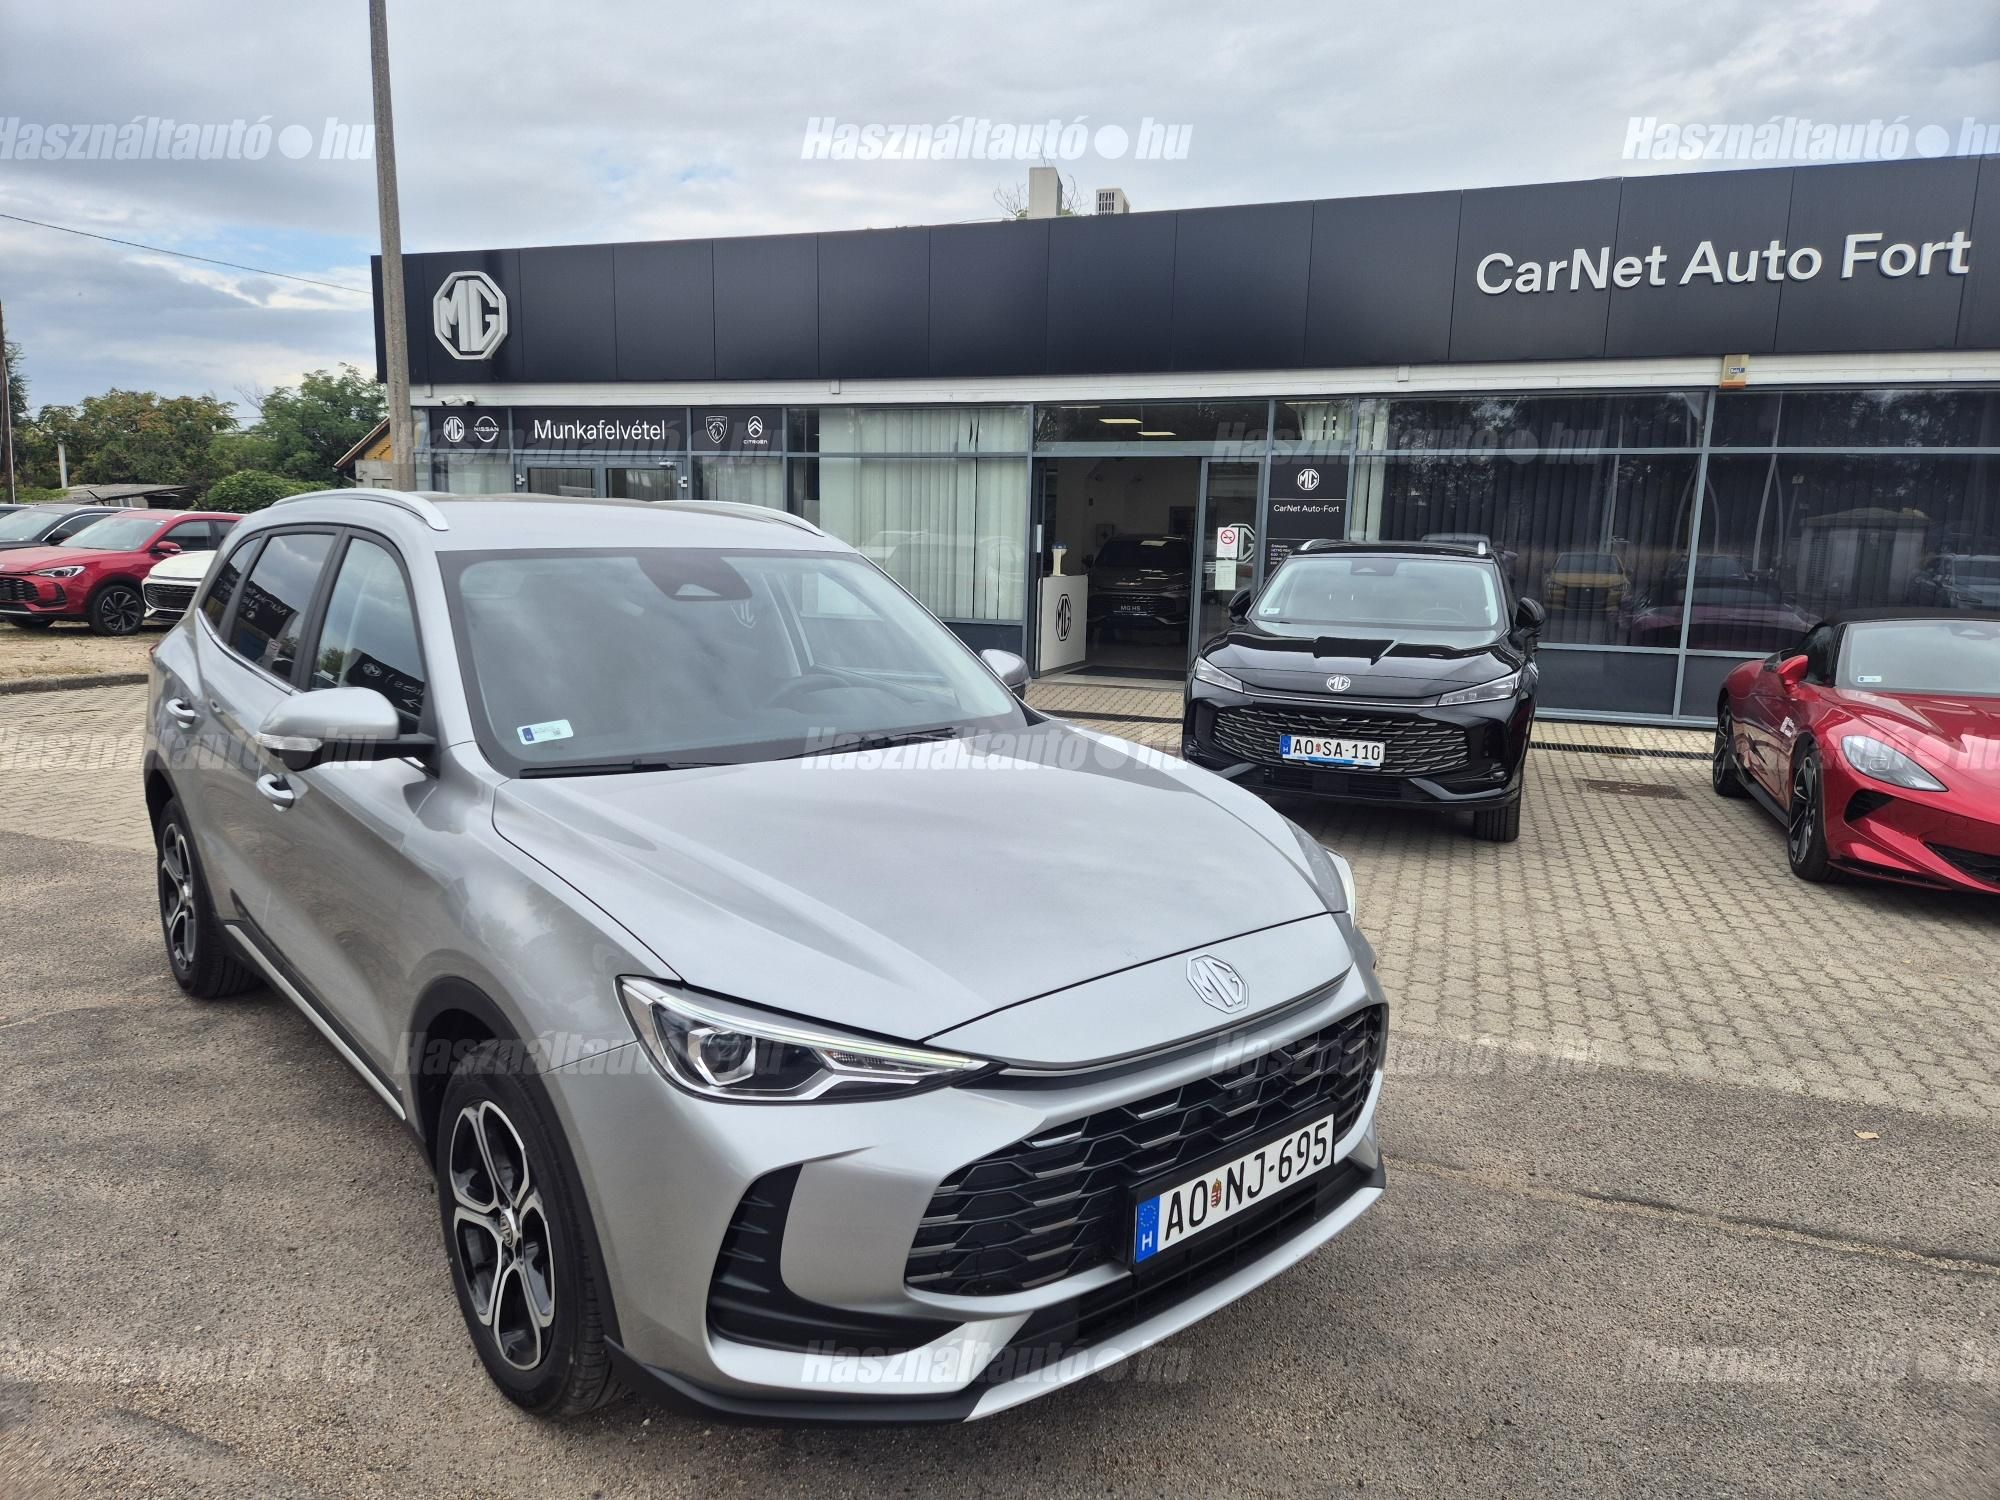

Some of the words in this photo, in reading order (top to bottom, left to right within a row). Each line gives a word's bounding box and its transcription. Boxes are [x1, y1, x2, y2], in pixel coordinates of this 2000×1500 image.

[1476, 245, 1667, 295] CarNet
[1678, 240, 1823, 285] Auto
[1840, 231, 1972, 279] Fort
[436, 275, 505, 356] MG
[445, 417, 463, 441] MG
[534, 419, 666, 440] Munkafelvétel
[1299, 470, 1318, 489] MG
[1273, 504, 1301, 513] CarNet
[1301, 504, 1340, 513] Auto-Fort
[1056, 596, 1072, 639] MG
[1328, 675, 1349, 691] MG
[1293, 739, 1314, 755] AO
[1322, 741, 1380, 760] SA-110
[1188, 956, 1246, 1010] MG
[1141, 1231, 1153, 1251] H
[1164, 1180, 1209, 1241] AO
[1225, 1121, 1329, 1212] NJ-695
